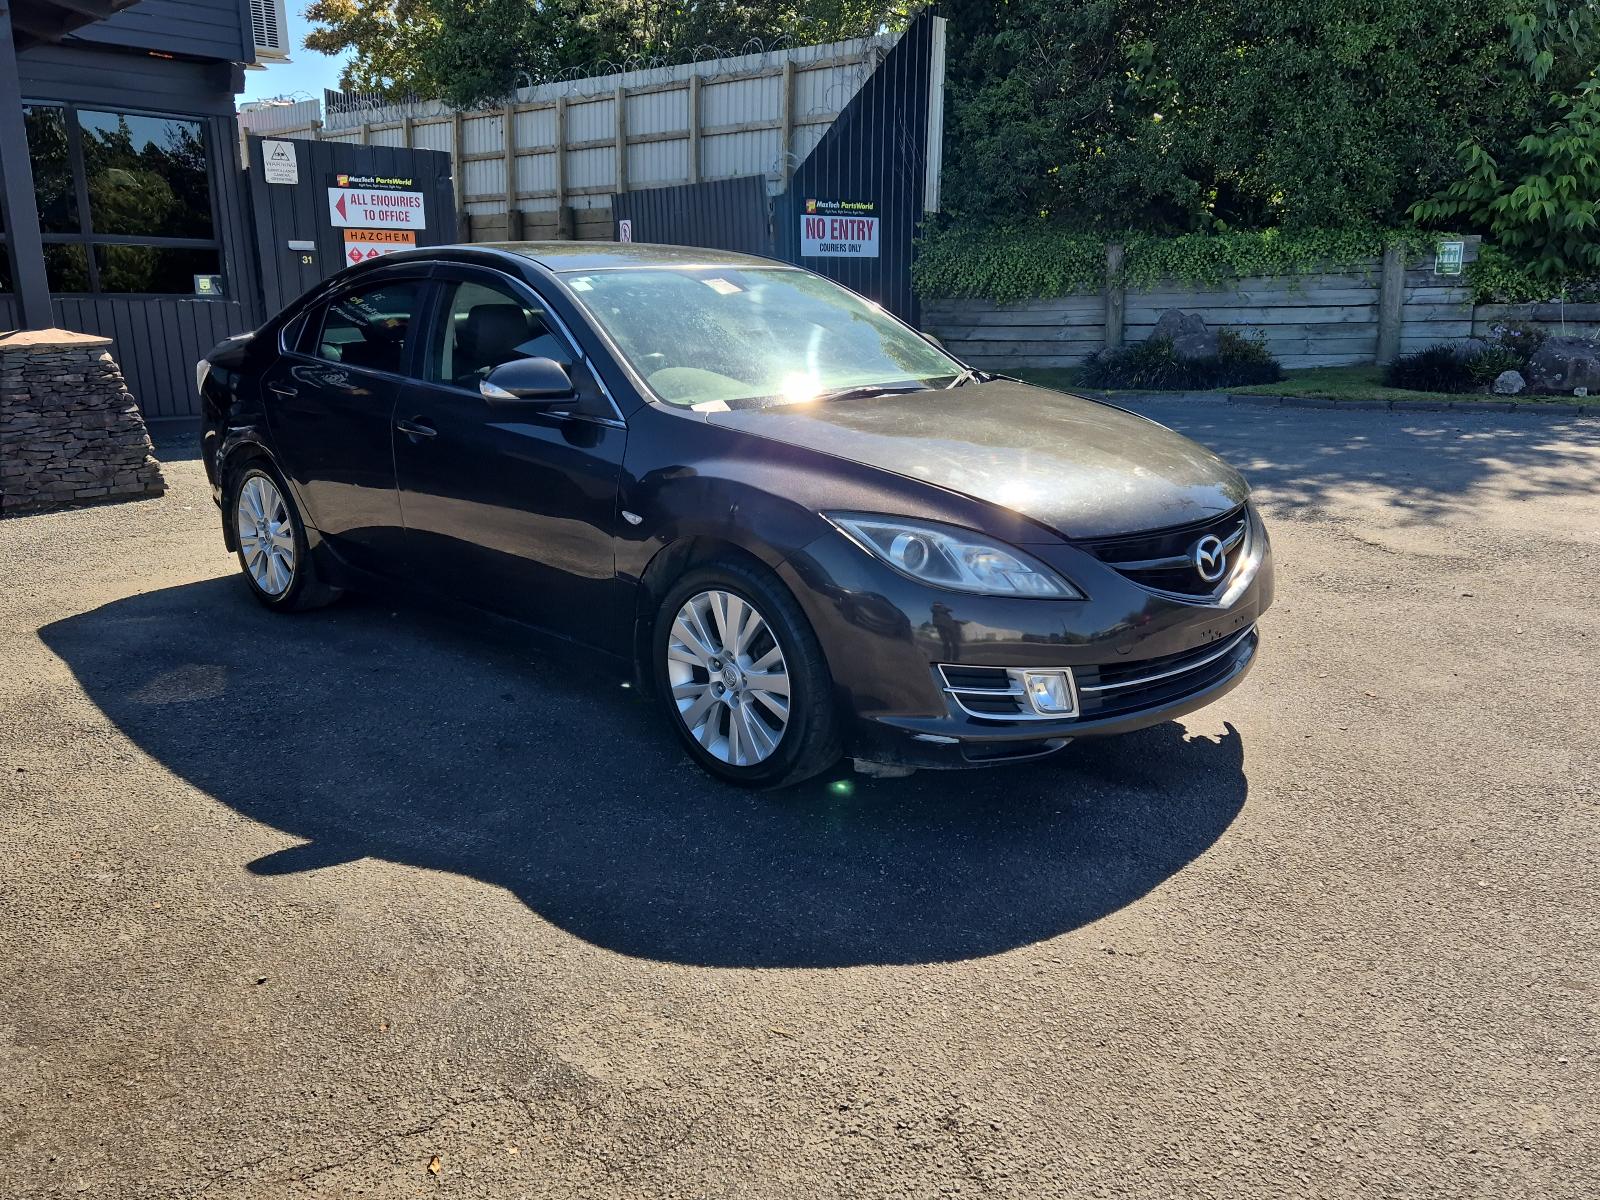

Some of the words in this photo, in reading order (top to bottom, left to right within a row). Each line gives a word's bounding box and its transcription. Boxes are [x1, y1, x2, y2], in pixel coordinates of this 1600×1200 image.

[375, 177, 412, 186] PartsWorld
[350, 193, 368, 206] ALL
[370, 194, 421, 208] ENQUIRIES
[841, 201, 874, 210] PartsWorld
[363, 209, 376, 221] TO
[378, 210, 411, 222] OFFICE
[805, 217, 826, 240] NO
[830, 218, 874, 241] ENTRY
[350, 231, 410, 242] HAZCHEM
[819, 243, 847, 253] COURIERS
[848, 243, 862, 253] ONLY
[302, 255, 313, 264] 31
